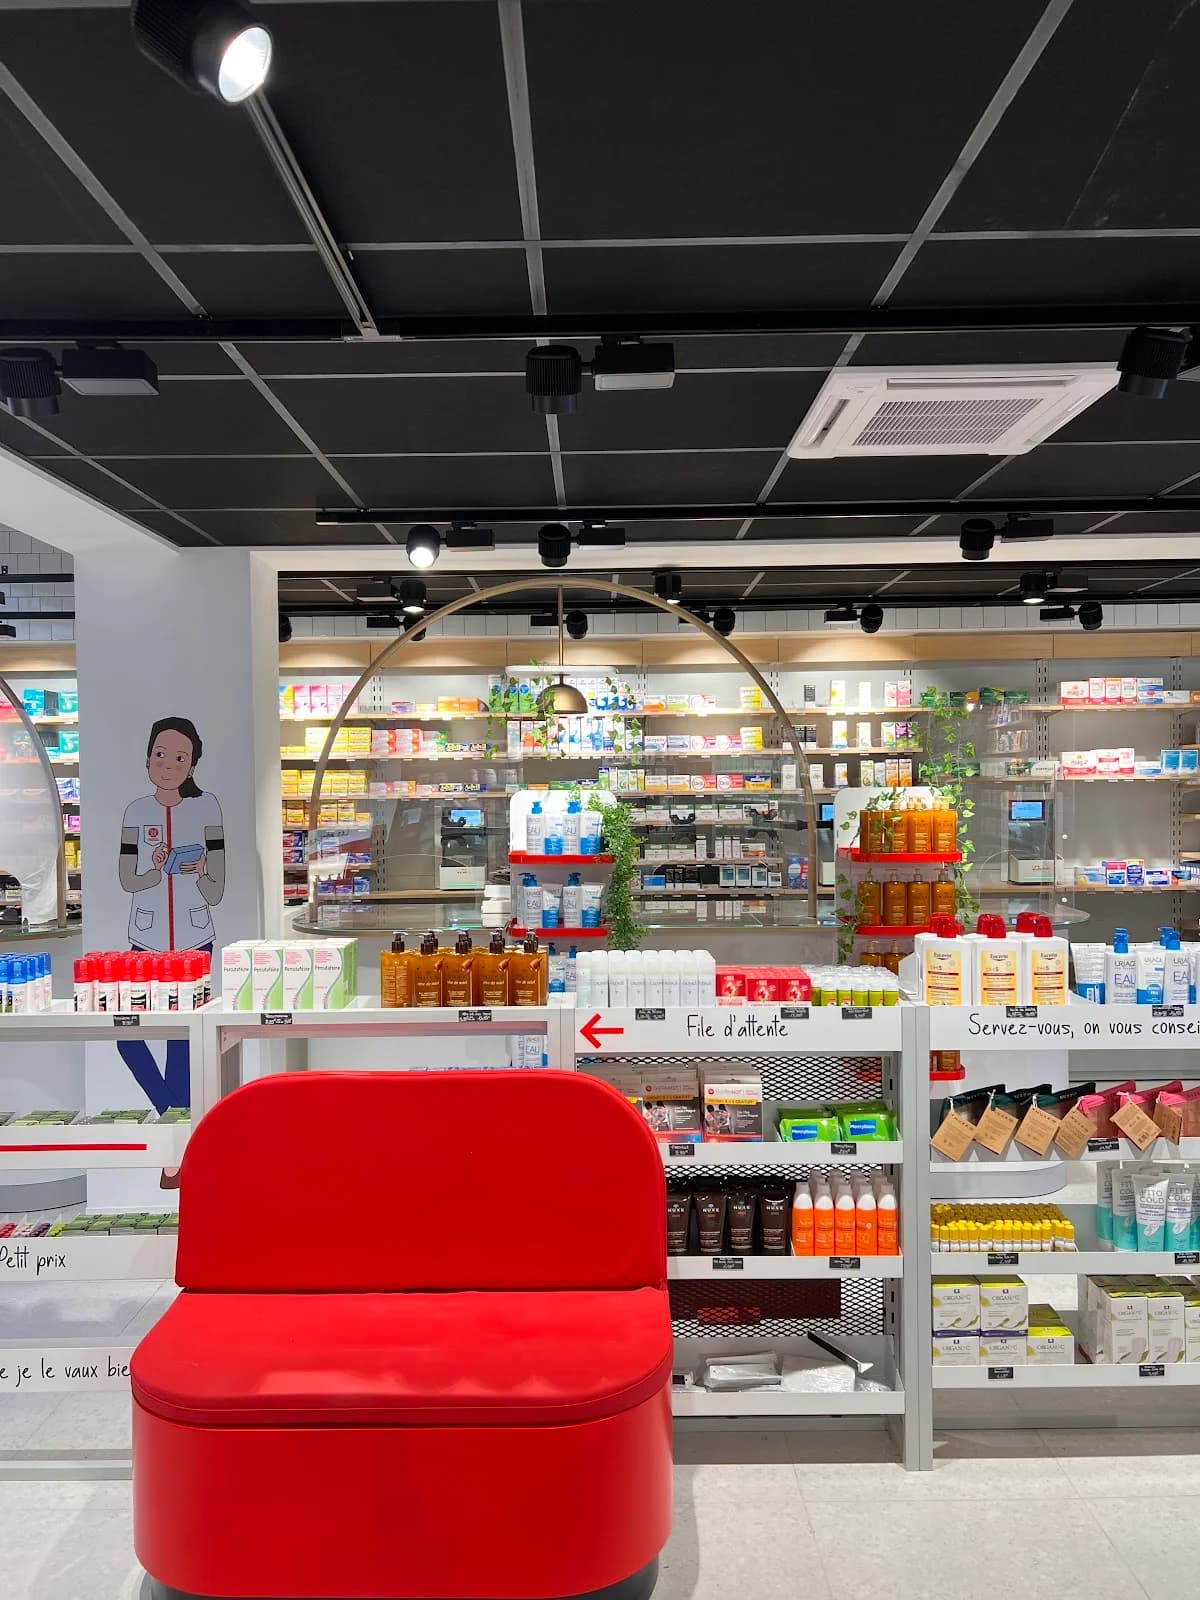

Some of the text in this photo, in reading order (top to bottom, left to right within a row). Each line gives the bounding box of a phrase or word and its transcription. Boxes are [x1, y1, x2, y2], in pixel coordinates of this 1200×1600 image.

[687, 1014, 715, 1037] File
[724, 1014, 789, 1037] d'attente
[968, 1013, 1200, 1039] Servez-vous, on vous consei
[0, 1245, 67, 1276] Petit prix
[15, 1365, 32, 1388] je
[41, 1357, 55, 1379] le
[64, 1365, 98, 1379] vaux
